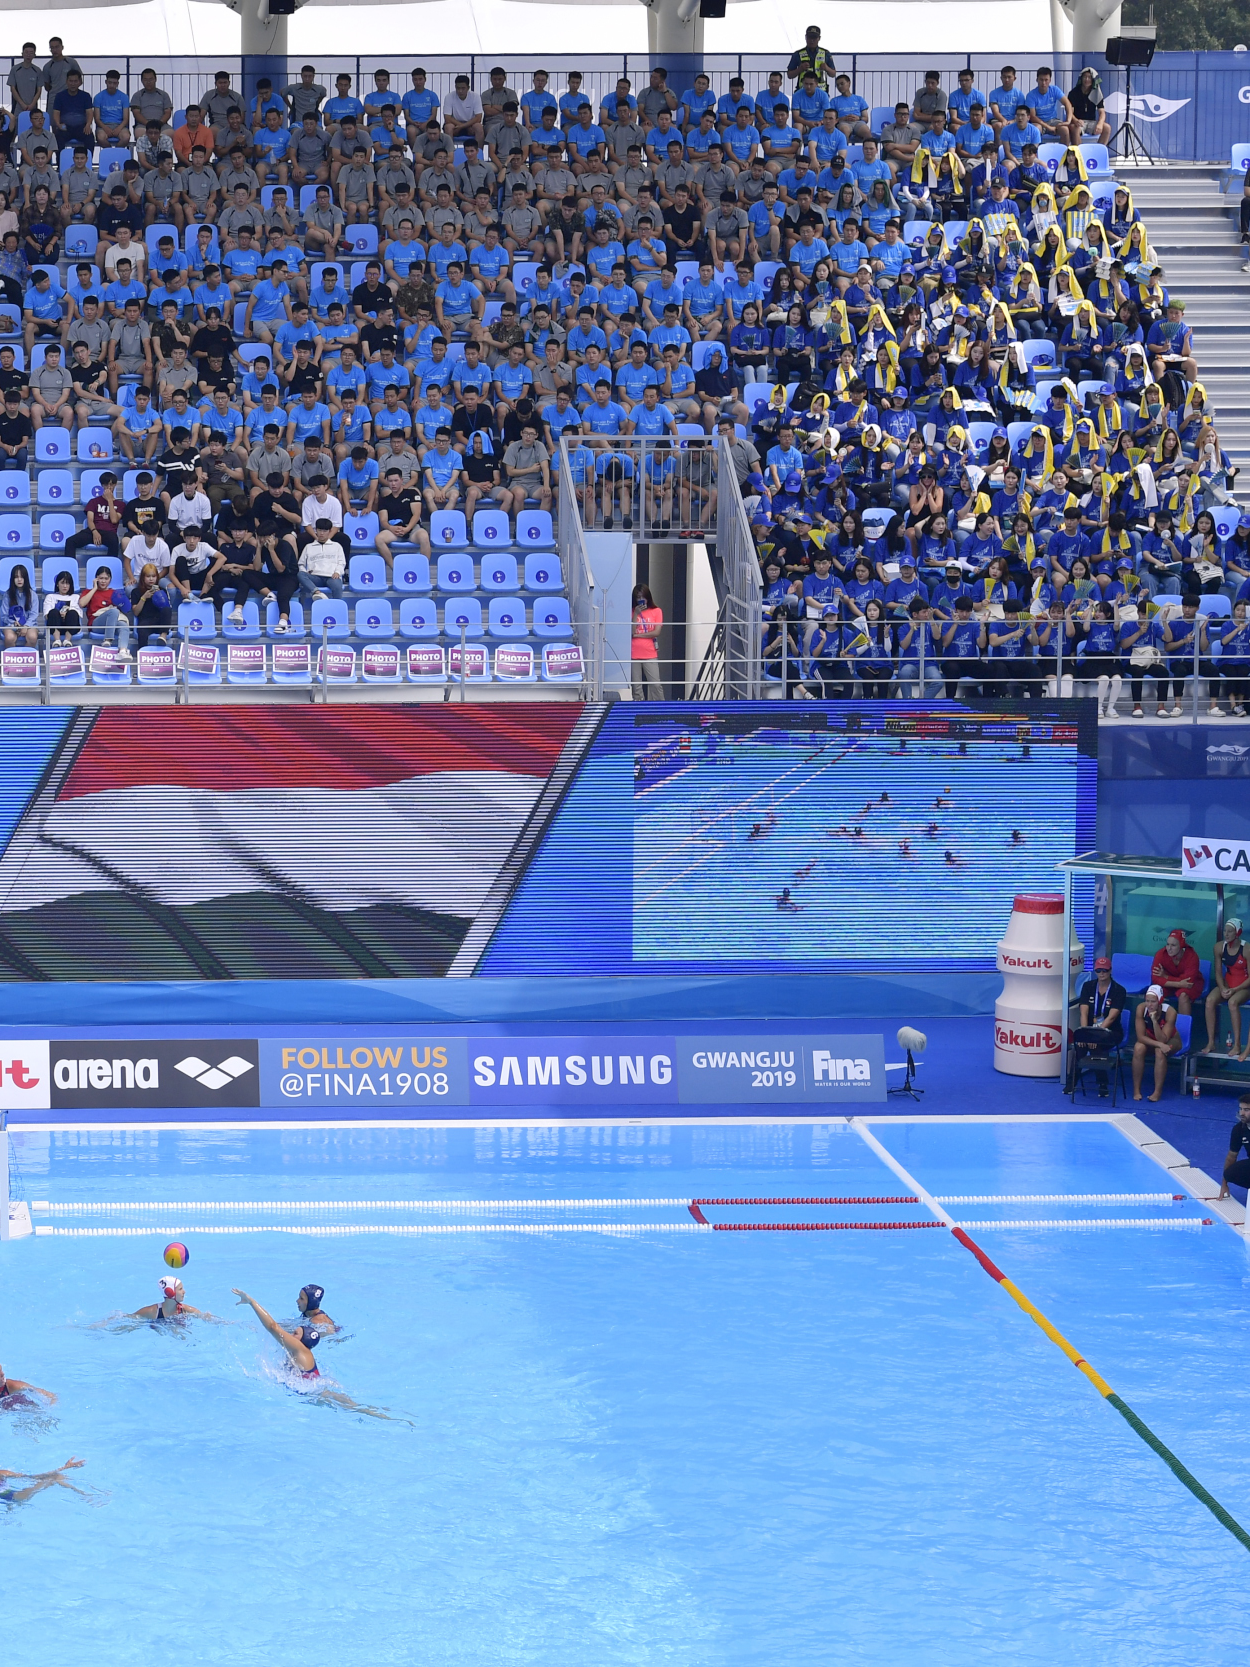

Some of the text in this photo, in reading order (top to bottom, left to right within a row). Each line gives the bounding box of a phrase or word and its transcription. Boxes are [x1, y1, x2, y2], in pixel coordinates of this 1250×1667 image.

[50, 652, 77, 661] PHOTO
[96, 651, 117, 660] PHO
[142, 654, 175, 663] PHOTO
[188, 650, 214, 658] HOTO
[366, 654, 396, 662] PHOTO
[411, 653, 440, 662] PHOTO
[498, 654, 528, 662] PHOTO
[549, 650, 578, 662] PHOTO
[1002, 954, 1053, 969] Yakult
[994, 1024, 1057, 1049] Yakult
[282, 1046, 448, 1069] FOLLOW US
[692, 1051, 795, 1070] GWANGJU
[473, 1054, 672, 1087] SAMSUNG
[812, 1050, 872, 1081] Fina
[53, 1056, 160, 1090] arena
[751, 1070, 796, 1088] 2019
[280, 1073, 450, 1098] @FINA1908
[158, 1280, 168, 1290] 3
[314, 1289, 322, 1298] 8
